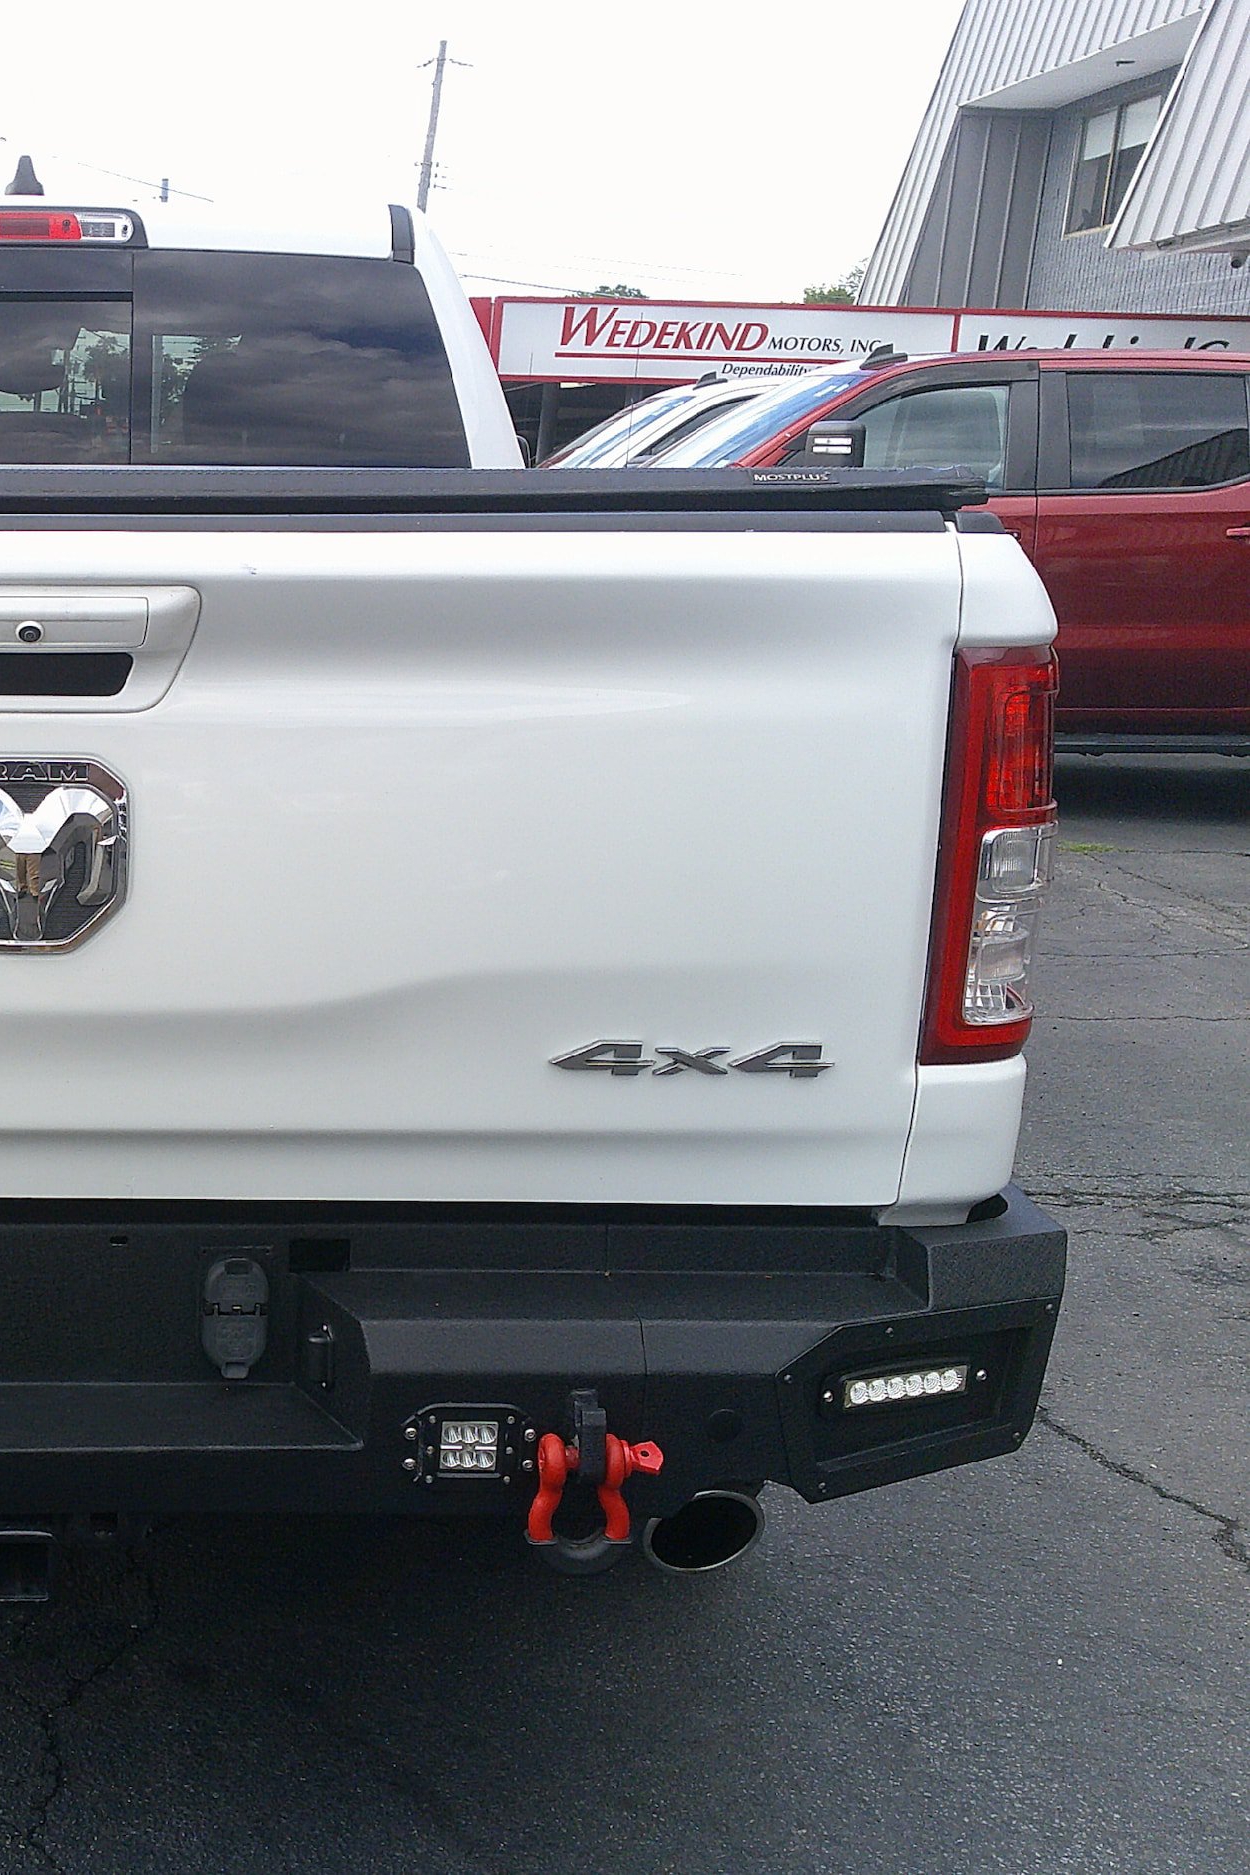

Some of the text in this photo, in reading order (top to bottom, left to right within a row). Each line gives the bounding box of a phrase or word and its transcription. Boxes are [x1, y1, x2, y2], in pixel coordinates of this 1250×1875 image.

[560, 306, 769, 351] WEDEKIND
[768, 336, 845, 355] MOTORS,
[754, 473, 829, 482] MOSTPLUS
